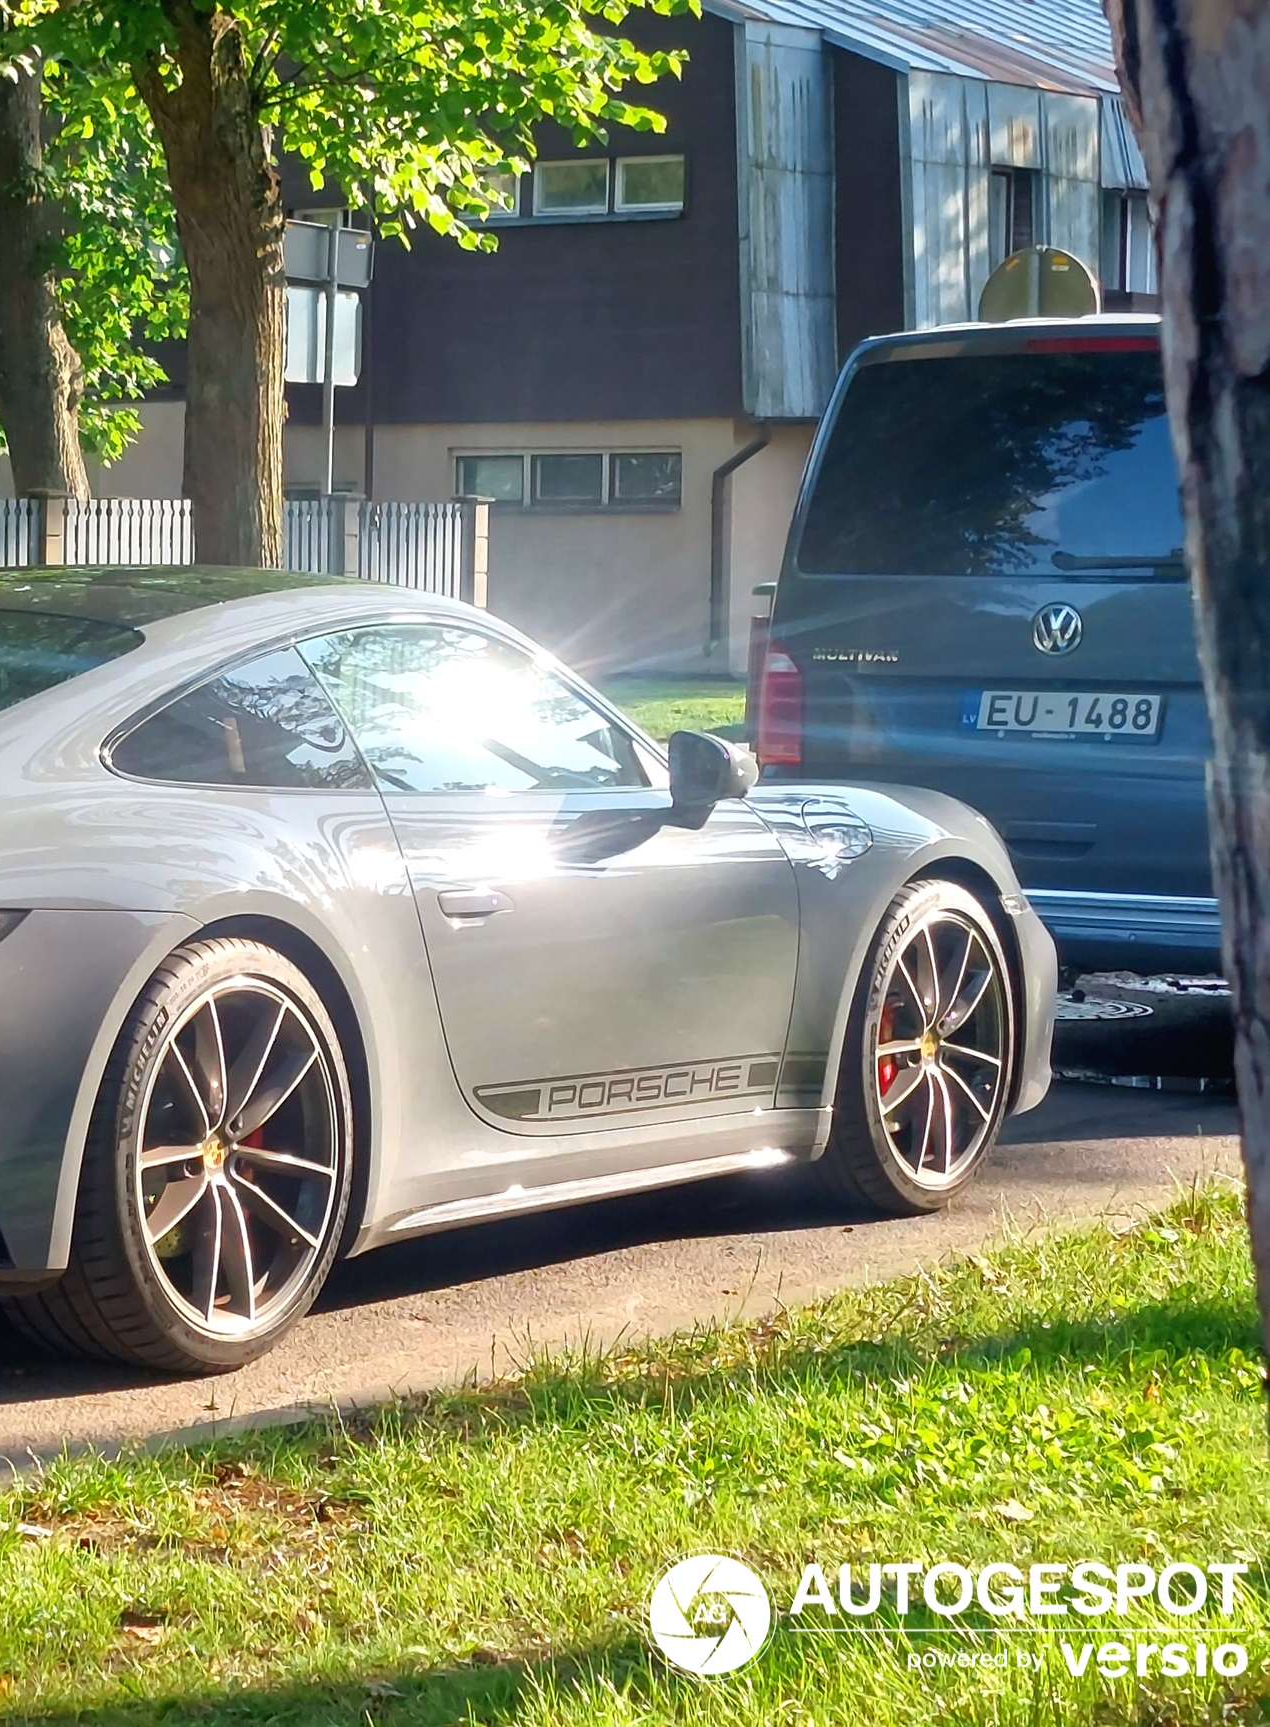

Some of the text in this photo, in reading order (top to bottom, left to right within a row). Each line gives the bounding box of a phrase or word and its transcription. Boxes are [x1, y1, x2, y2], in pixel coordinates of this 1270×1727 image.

[812, 647, 899, 662] MULTIVAN
[962, 714, 977, 724] LV
[986, 694, 1153, 731] EU-1488
[125, 1007, 166, 1111] MICHELIN
[548, 1065, 742, 1113] PORSCHE
